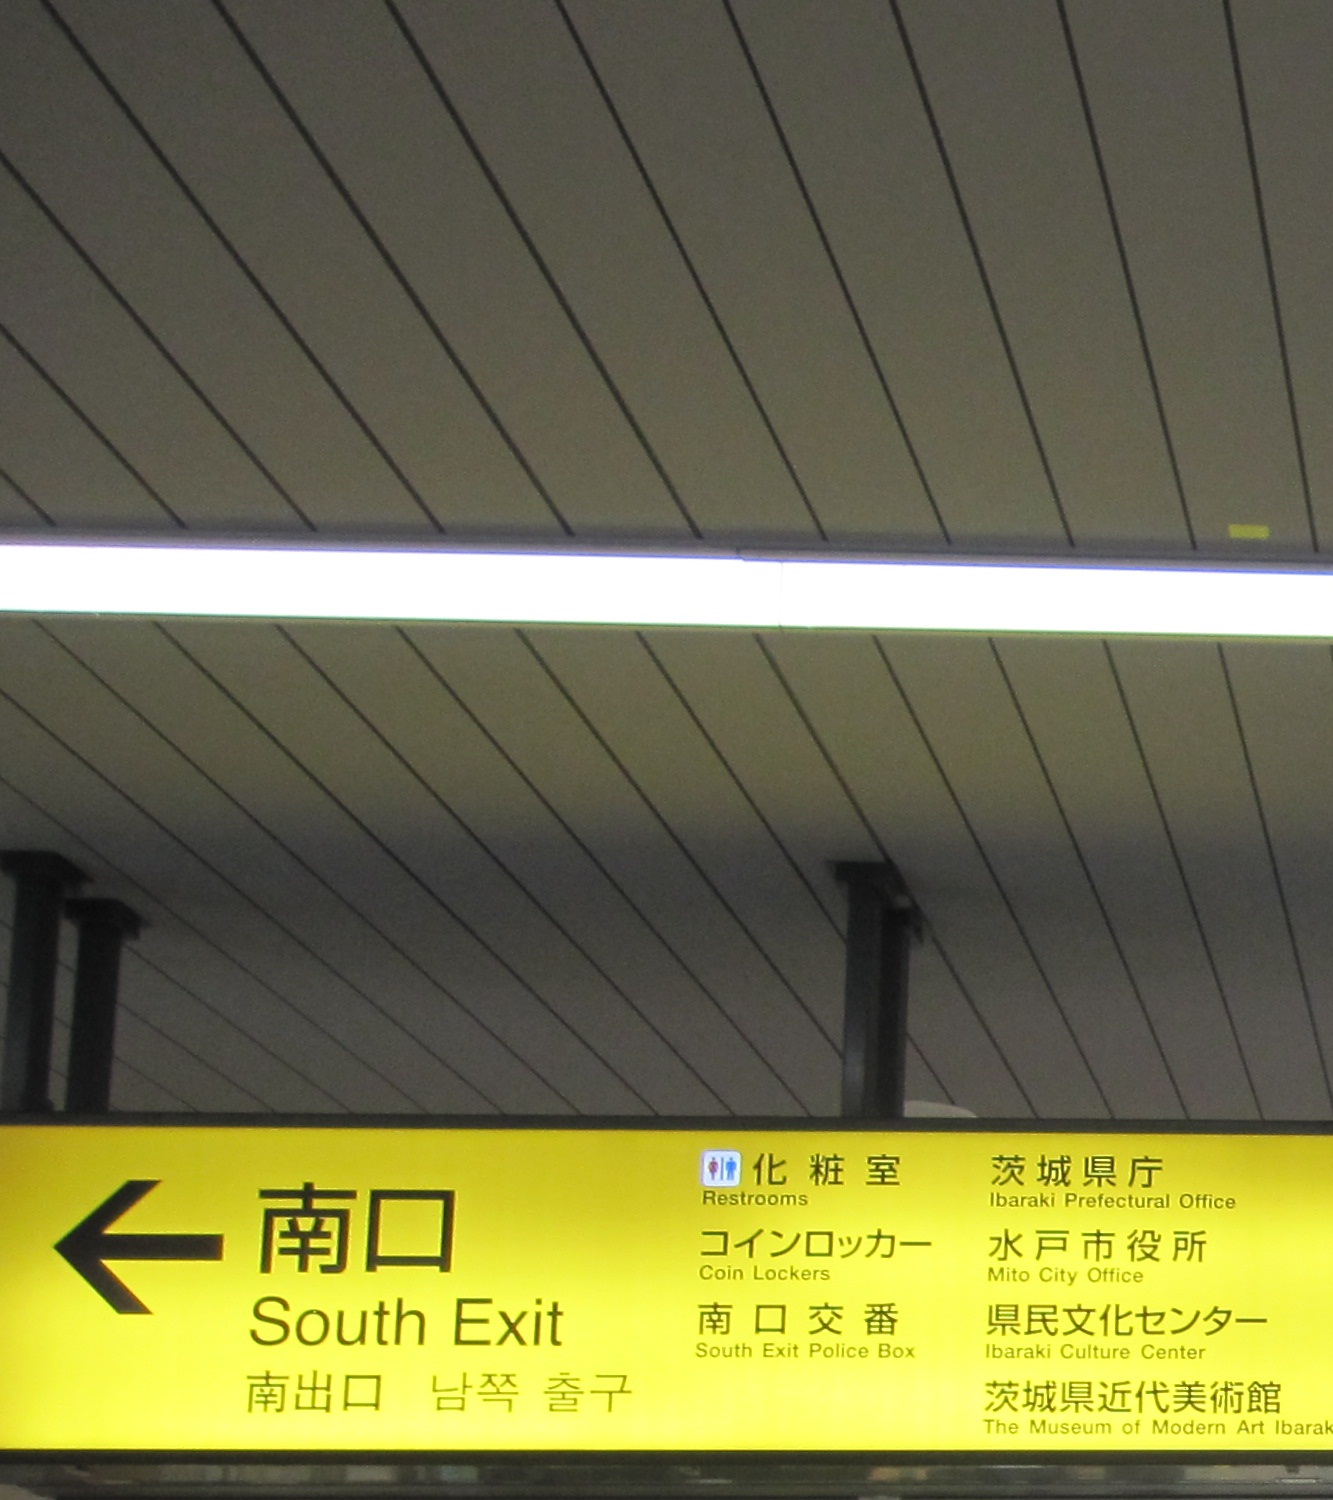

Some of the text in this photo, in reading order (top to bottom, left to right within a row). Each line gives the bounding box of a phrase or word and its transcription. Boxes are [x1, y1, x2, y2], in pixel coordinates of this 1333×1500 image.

[752, 1153, 902, 1187] 化粧室
[989, 1154, 1165, 1189] 茨城県庁
[701, 1190, 809, 1207] Restrooms
[989, 1192, 1237, 1211] Ibaraki Prefectural Office
[257, 1182, 457, 1275] 南口
[699, 1228, 933, 1259] コインロッカー
[987, 1229, 1208, 1264] 水戸市役所
[699, 1264, 831, 1282] Coin Lockers
[987, 1267, 1144, 1288] Mito City Office
[249, 1296, 563, 1347] South Exit
[697, 1302, 900, 1336] 南口交番
[985, 1303, 1269, 1339] 県民文化センター
[695, 1343, 916, 1360] South Exit Police Box
[985, 1343, 1206, 1361] Ibaraki Culture Center
[245, 1371, 383, 1414] 南出口
[430, 1371, 634, 1414] 남쪽 출구
[984, 1380, 1283, 1416] 茨城県近代美術館
[983, 1419, 1021, 1436] The
[1028, 1419, 1114, 1437] Museum
[1120, 1419, 1142, 1437] of
[1151, 1419, 1227, 1437] Modern
[1236, 1419, 1266, 1437] Art
